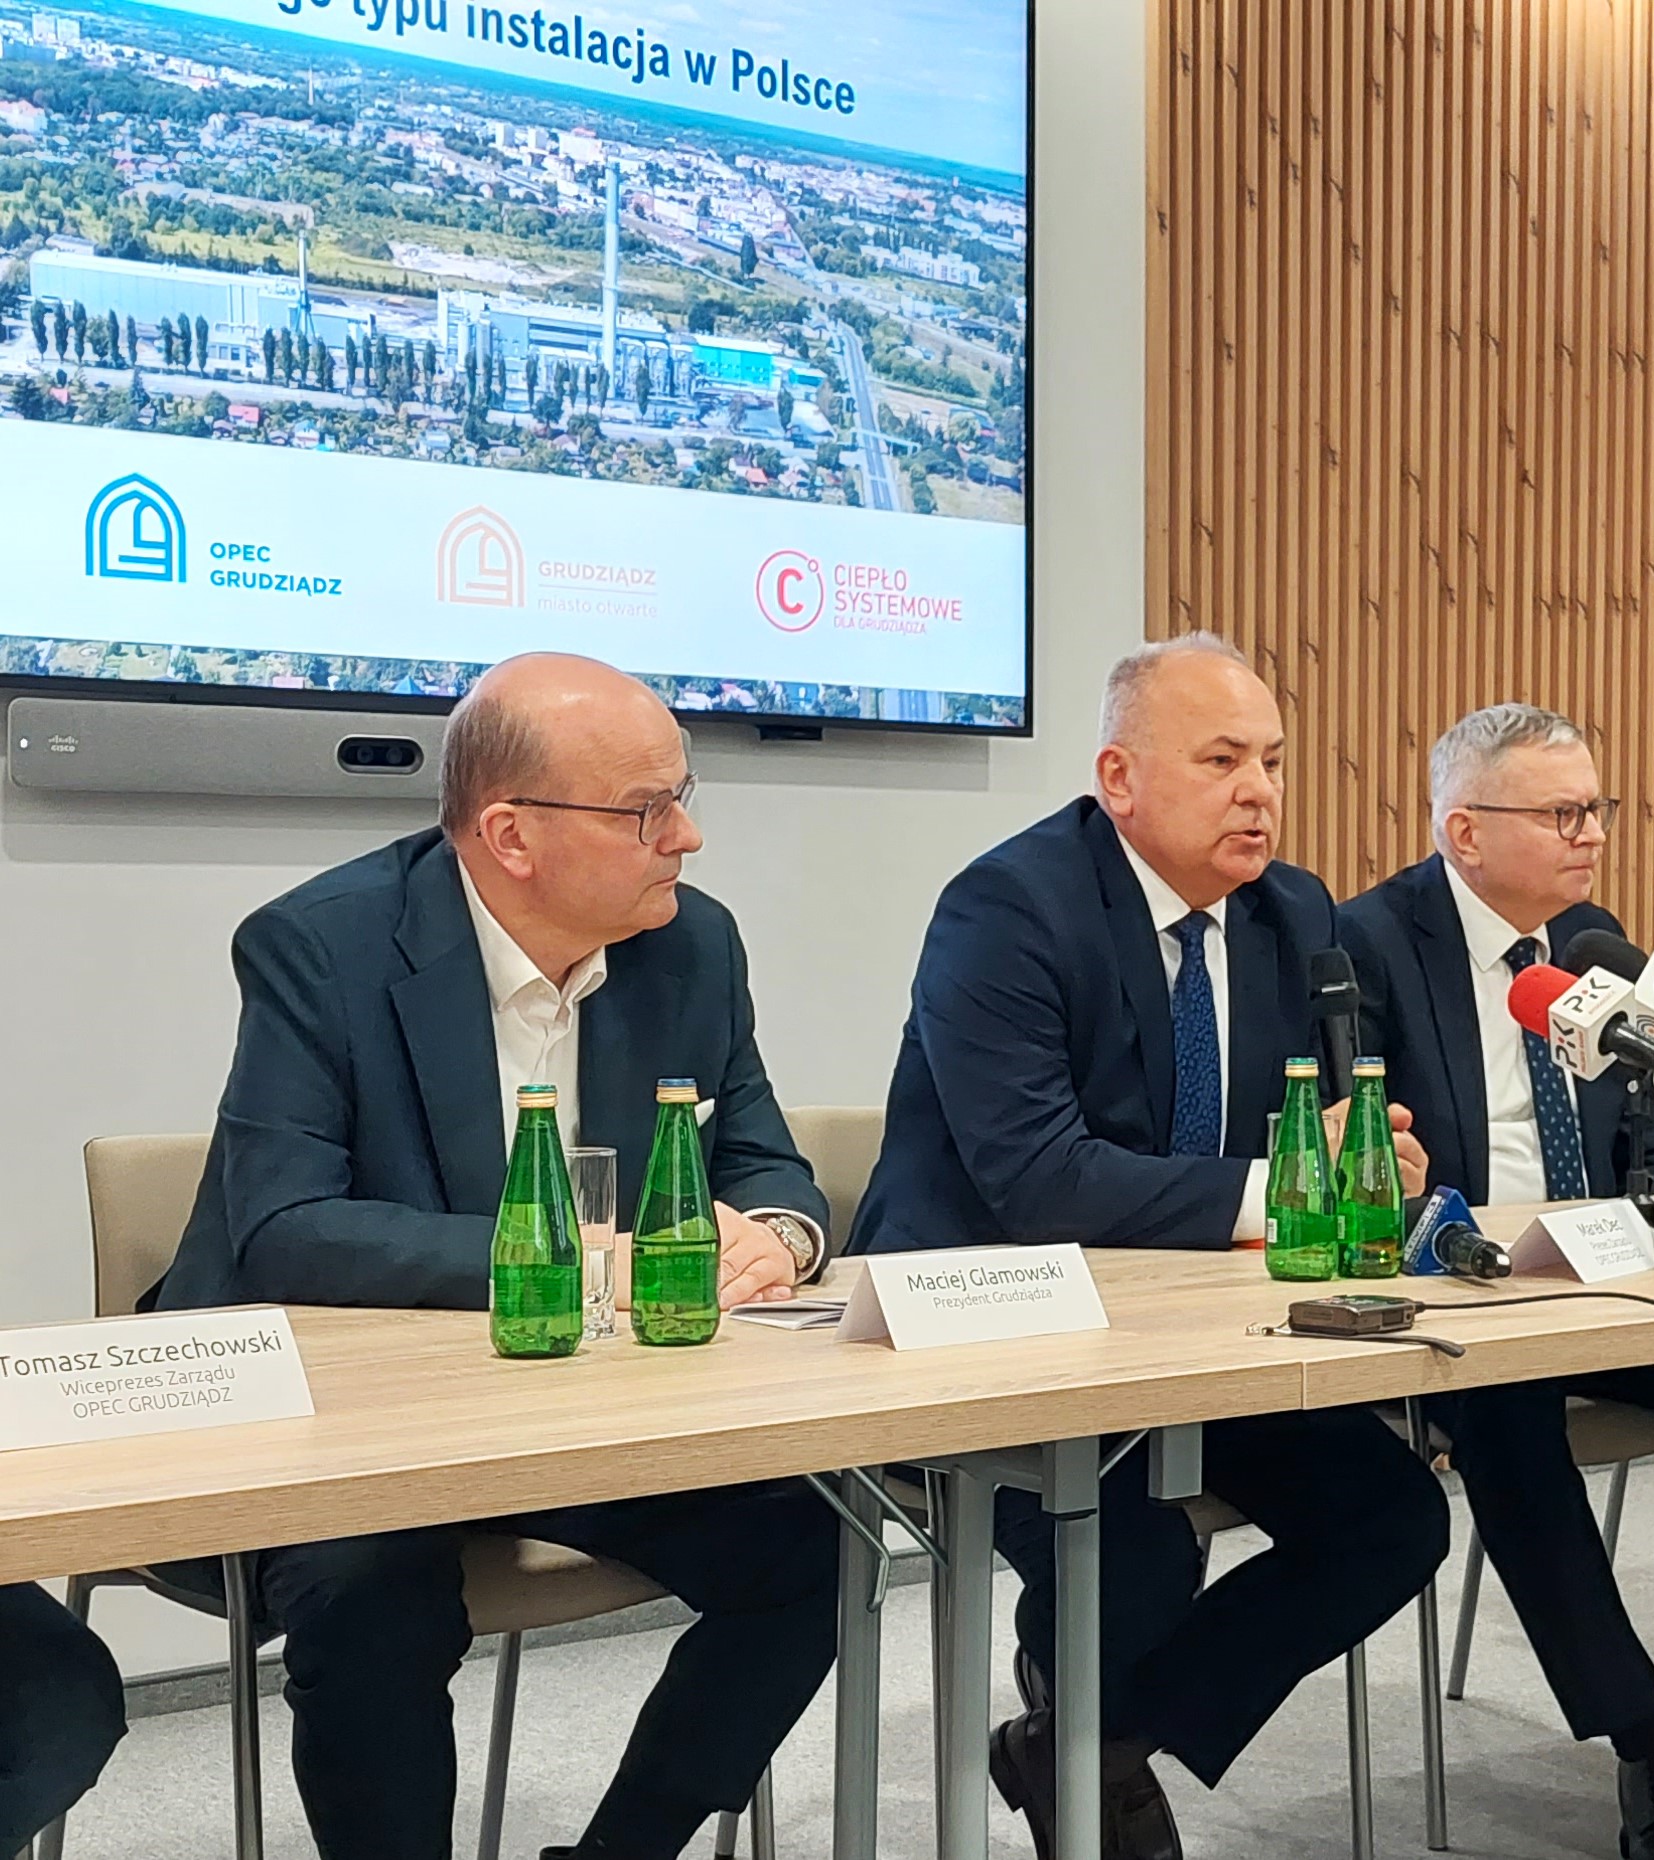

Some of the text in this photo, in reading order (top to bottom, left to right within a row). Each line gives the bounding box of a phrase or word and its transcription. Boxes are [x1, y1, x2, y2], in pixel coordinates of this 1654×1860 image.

[467, 0, 670, 84] instalacja
[684, 49, 717, 86] w
[732, 48, 856, 114] Polsce
[210, 542, 271, 562] OPEC
[210, 570, 342, 597] GRUDZIĄDZ
[538, 561, 657, 587] GRUDZIĄDZ
[834, 564, 907, 591] CIEPŁO
[538, 595, 658, 618] miasto otwarte
[834, 590, 963, 621] SYSTEMOWE
[833, 616, 927, 635] DLA GRUDZIĄDZA
[907, 1261, 1065, 1292] Maciej Glamowski
[933, 1287, 1053, 1310] Prezydent Grudziądza
[0, 1330, 283, 1378] Tomasz Szczechowski
[59, 1364, 236, 1397] Wiceprezes Zarządu
[73, 1386, 234, 1418] OPEC GRUDZIĄDZ
